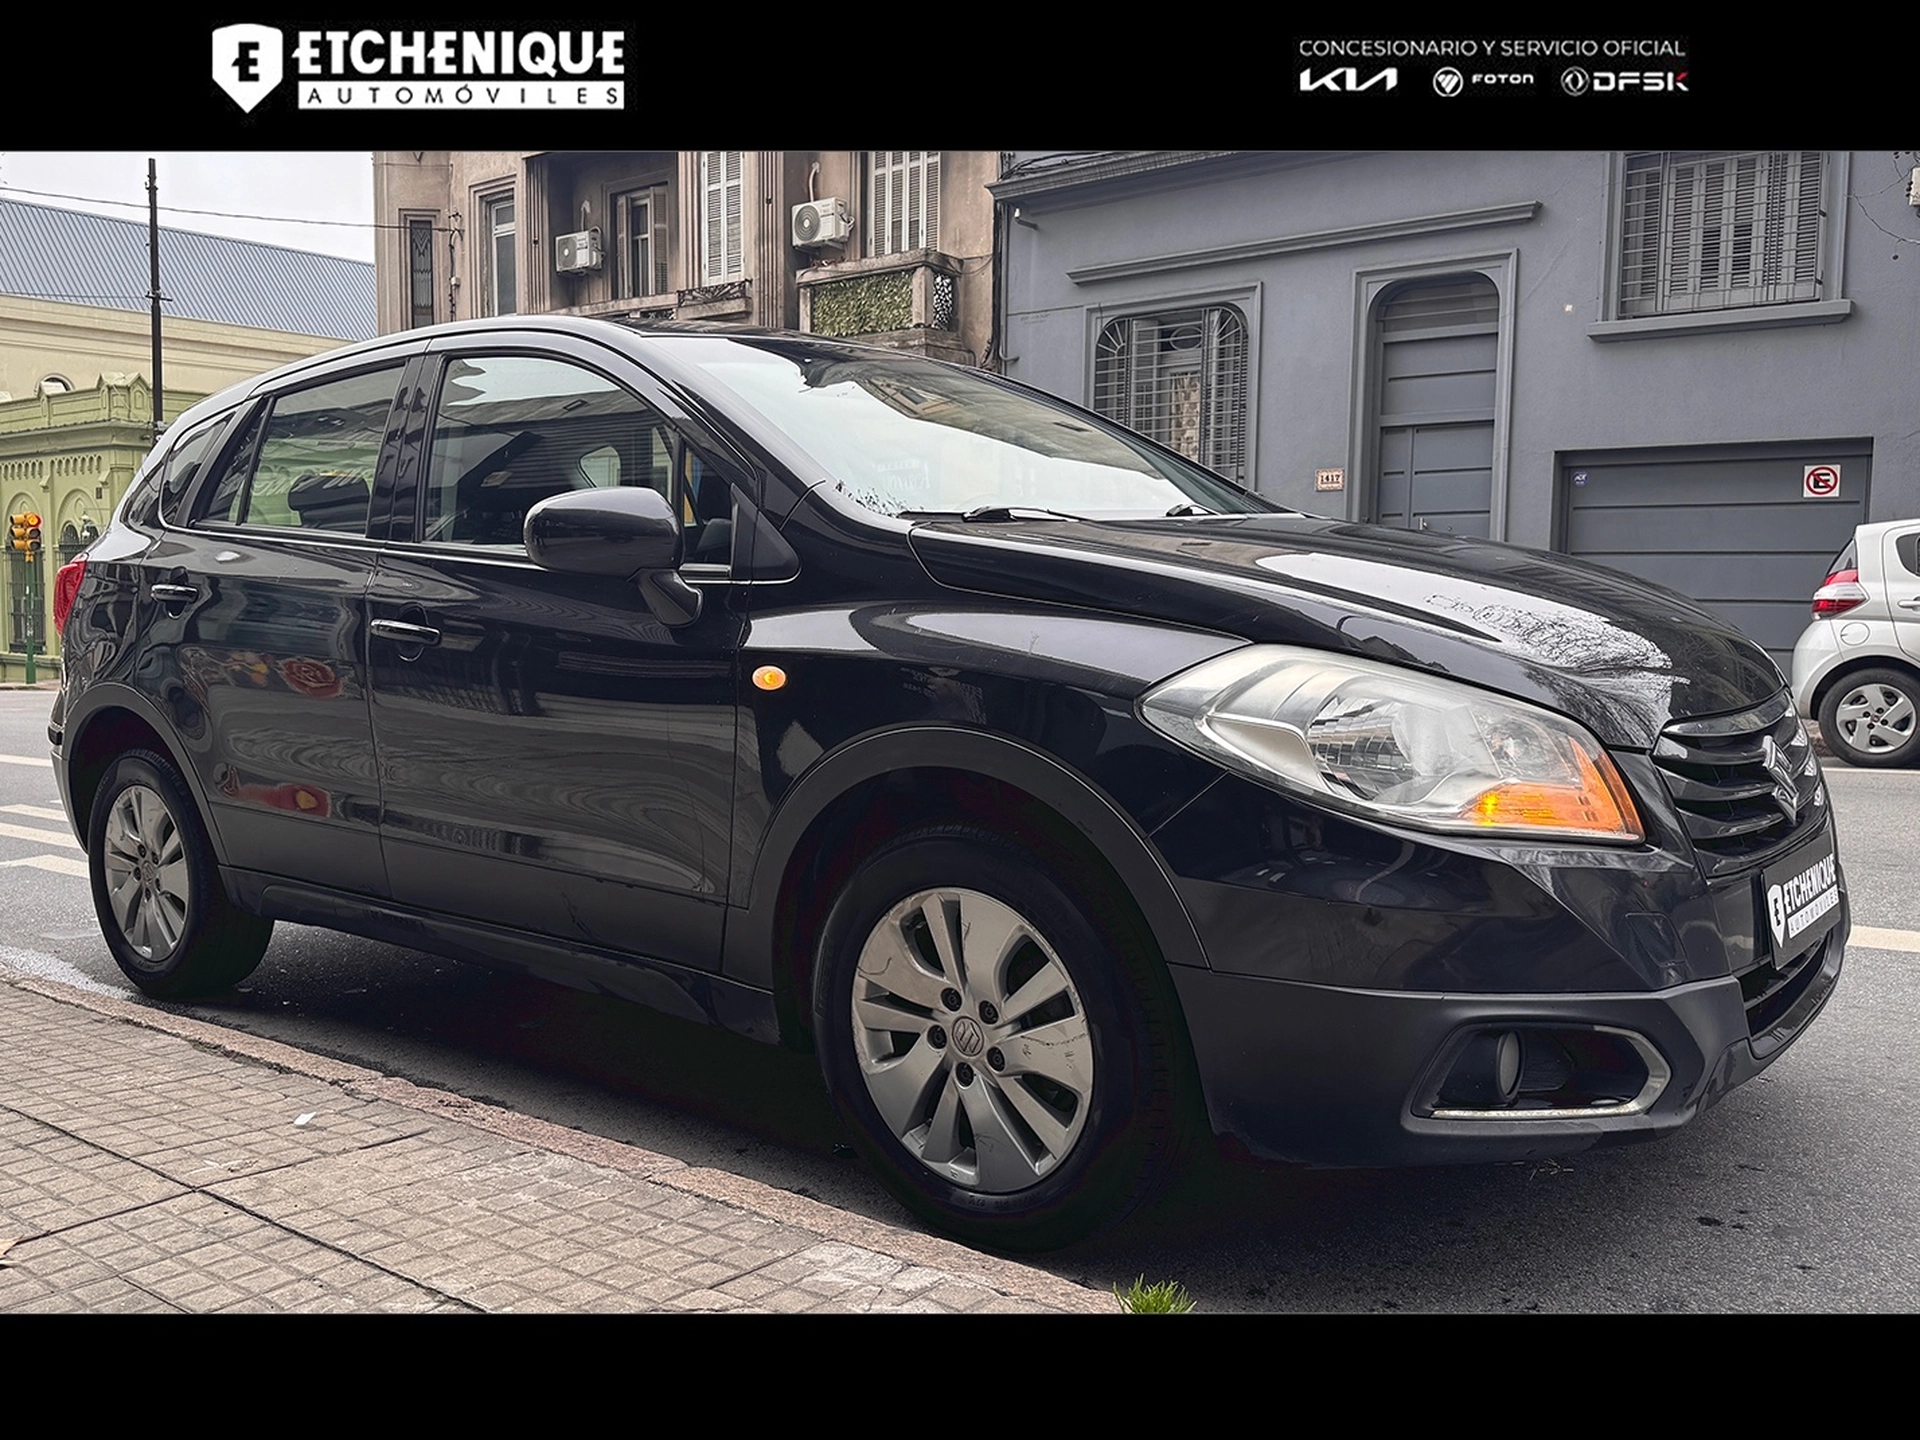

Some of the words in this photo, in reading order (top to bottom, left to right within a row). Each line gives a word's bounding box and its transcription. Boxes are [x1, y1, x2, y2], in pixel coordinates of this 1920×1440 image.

[1321, 474, 1340, 482] 1417
[1813, 472, 1831, 489] E
[1782, 853, 1837, 915] ETCHENIQUE
